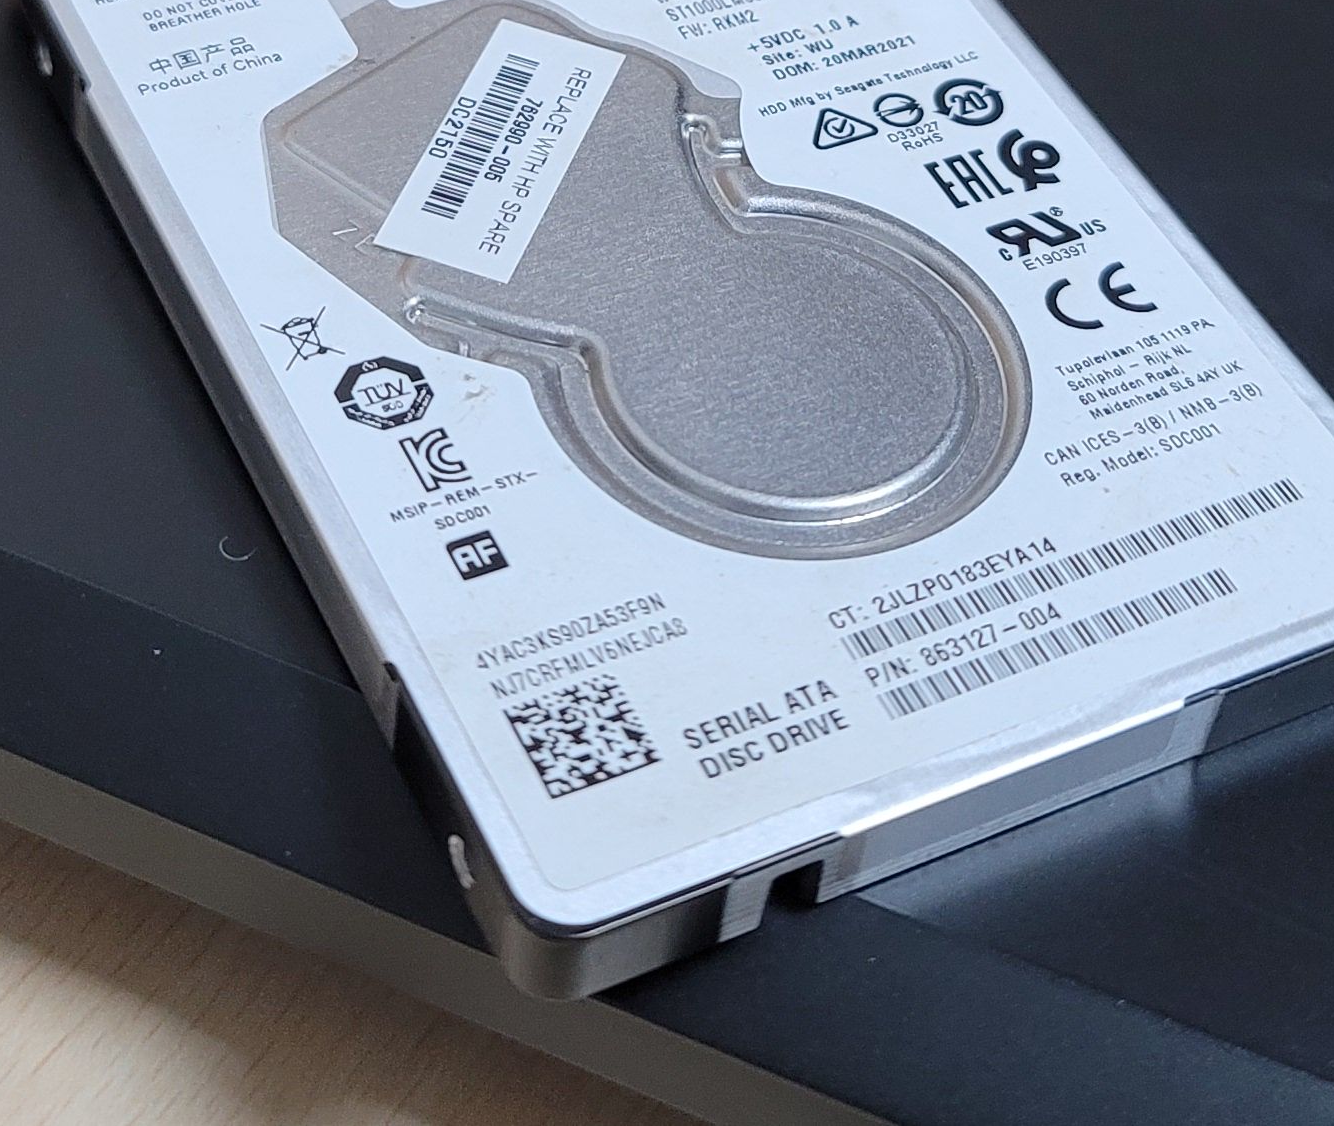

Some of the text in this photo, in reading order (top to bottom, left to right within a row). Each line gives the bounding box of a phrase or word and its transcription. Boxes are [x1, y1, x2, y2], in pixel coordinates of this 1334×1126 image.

[143, 10, 163, 22] DO
[166, 2, 195, 16] NOT
[149, 7, 223, 32] BREATHER
[677, 10, 759, 40] FW: RKM2
[747, 15, 859, 52] +5VDC 1.0 A
[761, 38, 833, 66] Site: WU
[137, 53, 283, 96] Product of China
[149, 36, 255, 74] 中国产品
[773, 35, 917, 80] DOM: 20MAR2021
[759, 51, 979, 118] HDD Mfg by Seagate Technology LLC
[950, 90, 988, 115] 20
[428, 96, 477, 160] DC2150
[483, 96, 543, 183] 762990-005
[887, 120, 940, 144] D33027
[901, 132, 944, 152] RoHS
[478, 66, 593, 256] REPLACE WITH HP SPARE
[1079, 218, 1107, 236] US
[1021, 242, 1089, 271] E190397
[1045, 261, 1159, 330] CE
[1055, 345, 1135, 376] Tupolevlaan
[1135, 334, 1159, 349] 105
[1160, 324, 1191, 342] 1119
[1067, 365, 1127, 392] Schiphol
[1144, 349, 1173, 366] Rijk
[1173, 343, 1193, 356] NL
[1078, 392, 1097, 406] 60
[1098, 377, 1146, 400] Norden
[1089, 360, 1244, 421] Maidenhead SL6 4AY UK
[1043, 442, 1081, 466] CAN
[1059, 422, 1223, 487] Reg. Model: SDC001
[433, 505, 492, 530] SDC001
[450, 536, 501, 576] AF
[827, 537, 1057, 630] CT: 2JLZP0183EYA14
[864, 602, 1063, 688] P/N: 863127-004
[683, 678, 839, 750] SERIAL ATA
[698, 708, 851, 779] DISC DRIVE
